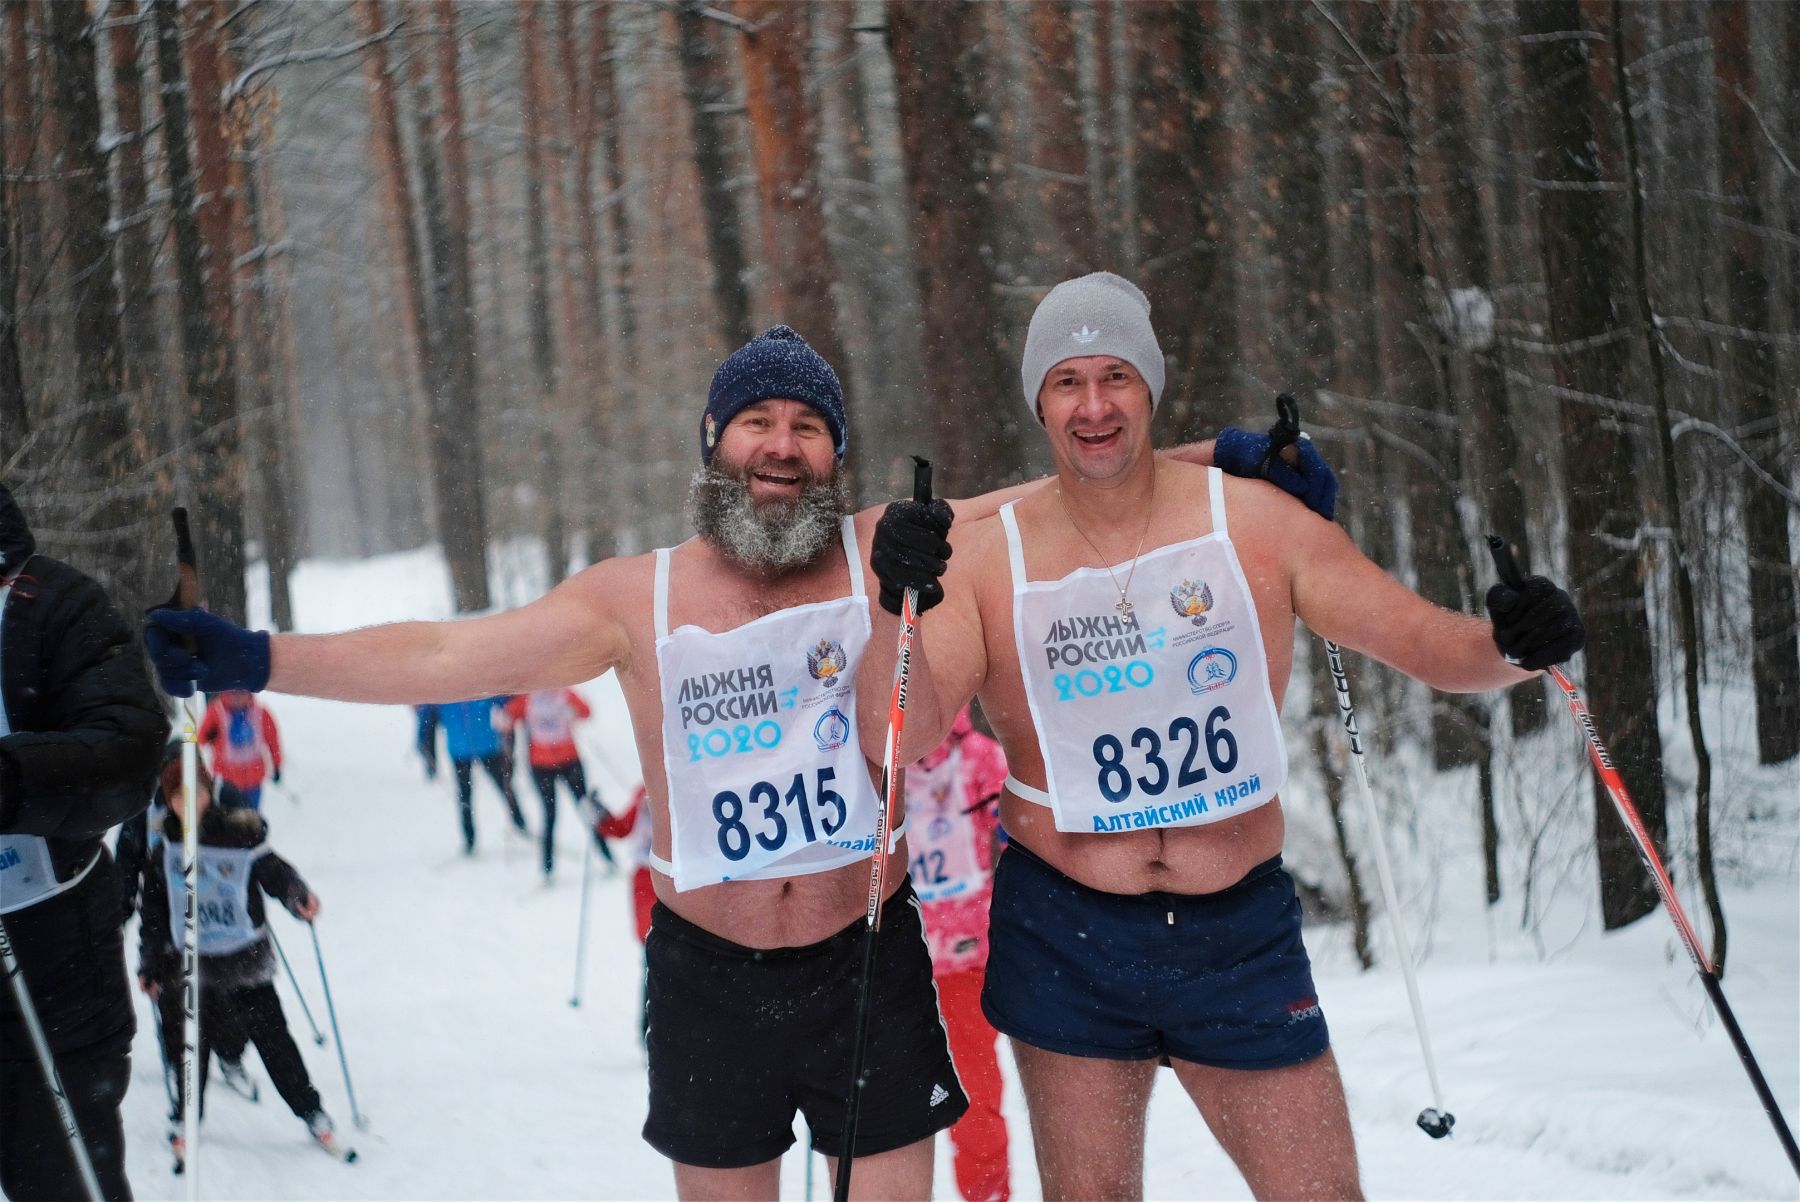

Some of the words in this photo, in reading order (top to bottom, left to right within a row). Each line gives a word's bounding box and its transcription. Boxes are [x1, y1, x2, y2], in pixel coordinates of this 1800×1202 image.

[1042, 611, 1141, 645] ЛЫЖНЯ
[1046, 634, 1147, 669] РОССИИ
[678, 663, 774, 704] ЛЫЖНЯ
[898, 648, 911, 710] MAXIM
[1053, 660, 1154, 701] 2020
[681, 690, 778, 729] РОССИИ
[687, 720, 782, 763] 2020
[1093, 705, 1239, 804] 8326
[712, 766, 847, 862] 8315
[1093, 792, 1209, 833] Алтайский
[1214, 772, 1261, 809] край
[867, 859, 881, 918] EMOTION
